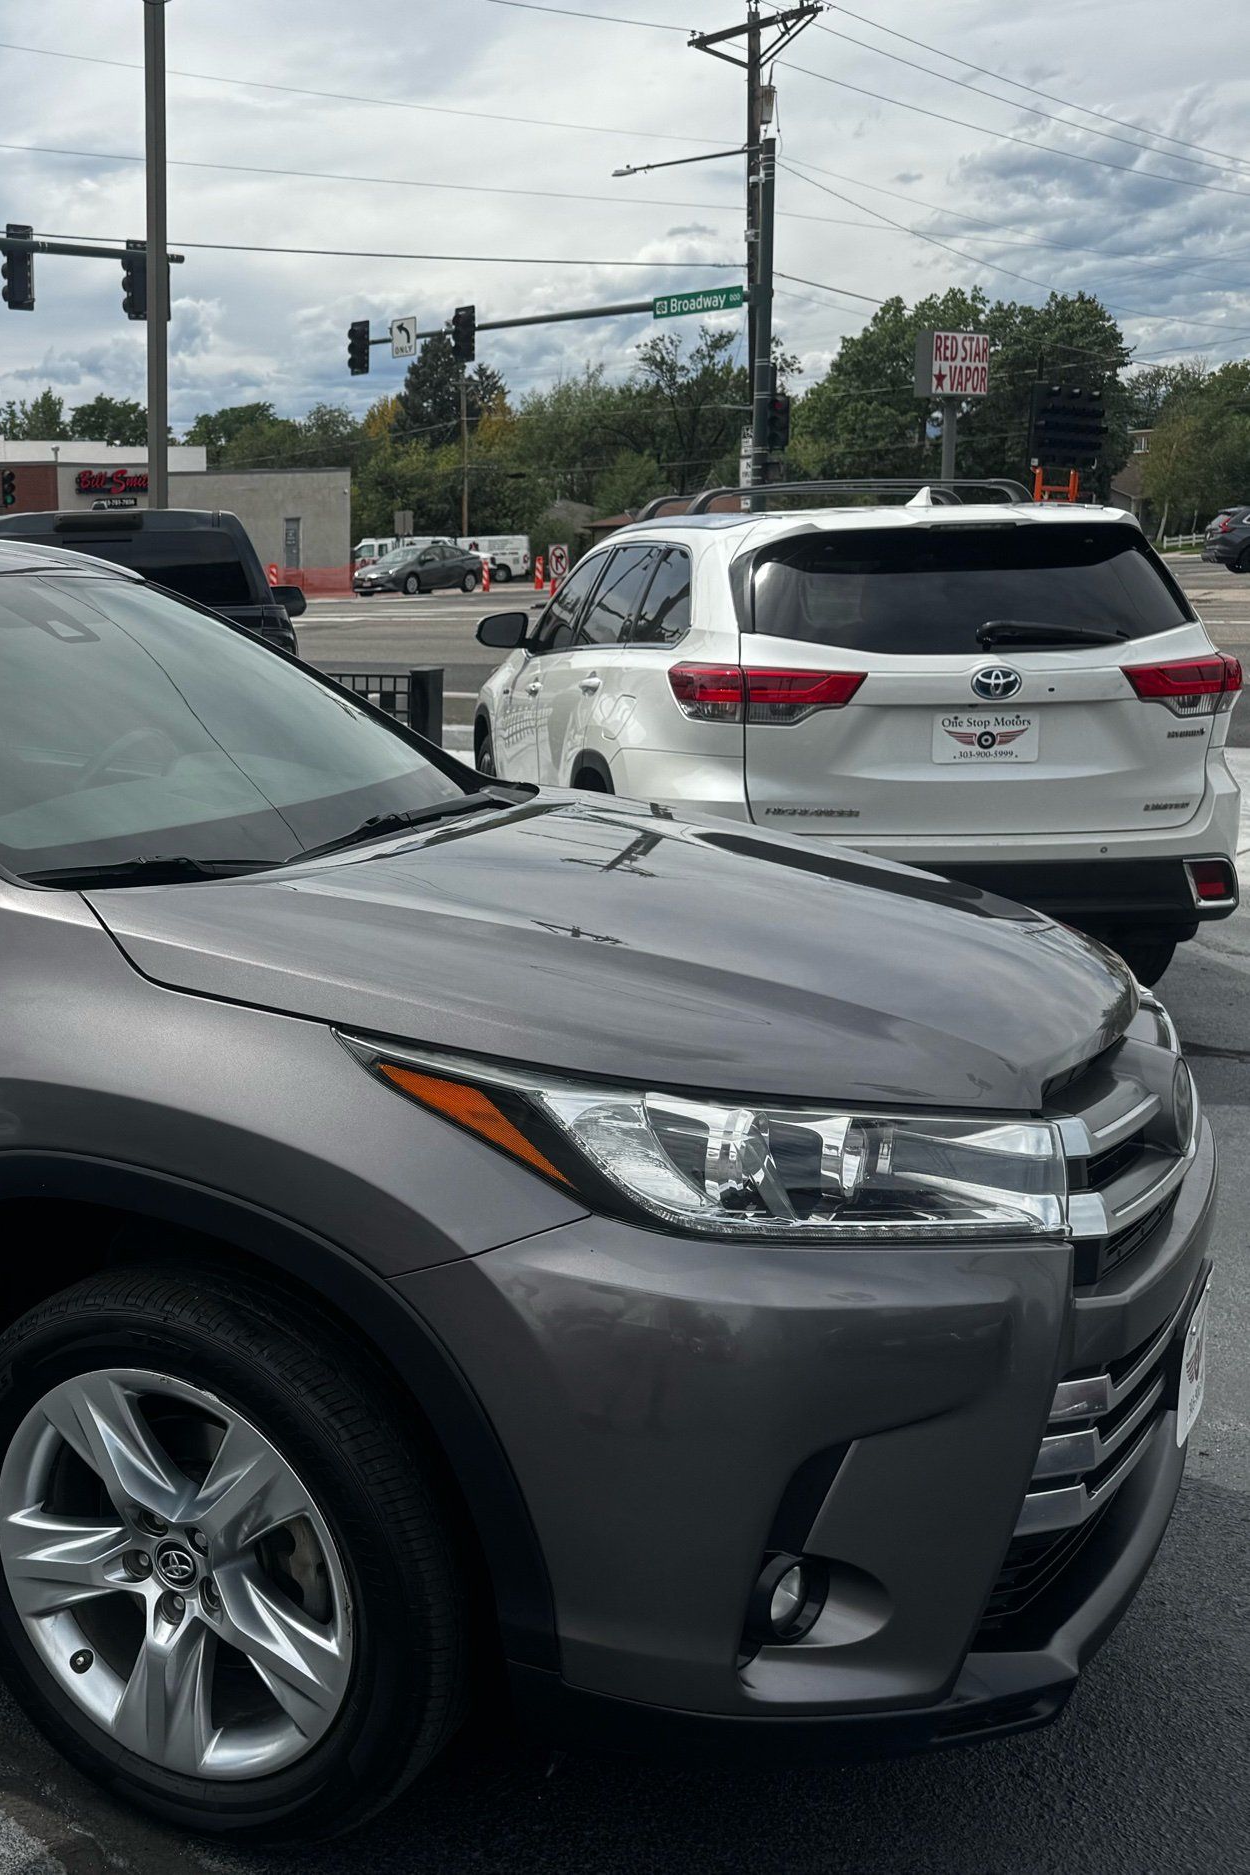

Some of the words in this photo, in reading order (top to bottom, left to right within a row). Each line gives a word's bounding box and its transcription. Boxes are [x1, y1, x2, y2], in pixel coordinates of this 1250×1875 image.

[670, 294, 726, 313] Broadway
[395, 345, 413, 355] ONLY
[934, 334, 958, 362] RED
[961, 336, 989, 363] STAR
[949, 365, 987, 392] VAPOR
[79, 469, 107, 488] Bill
[941, 717, 963, 728] One
[966, 717, 990, 729] Stop
[994, 716, 1031, 727] Motors
